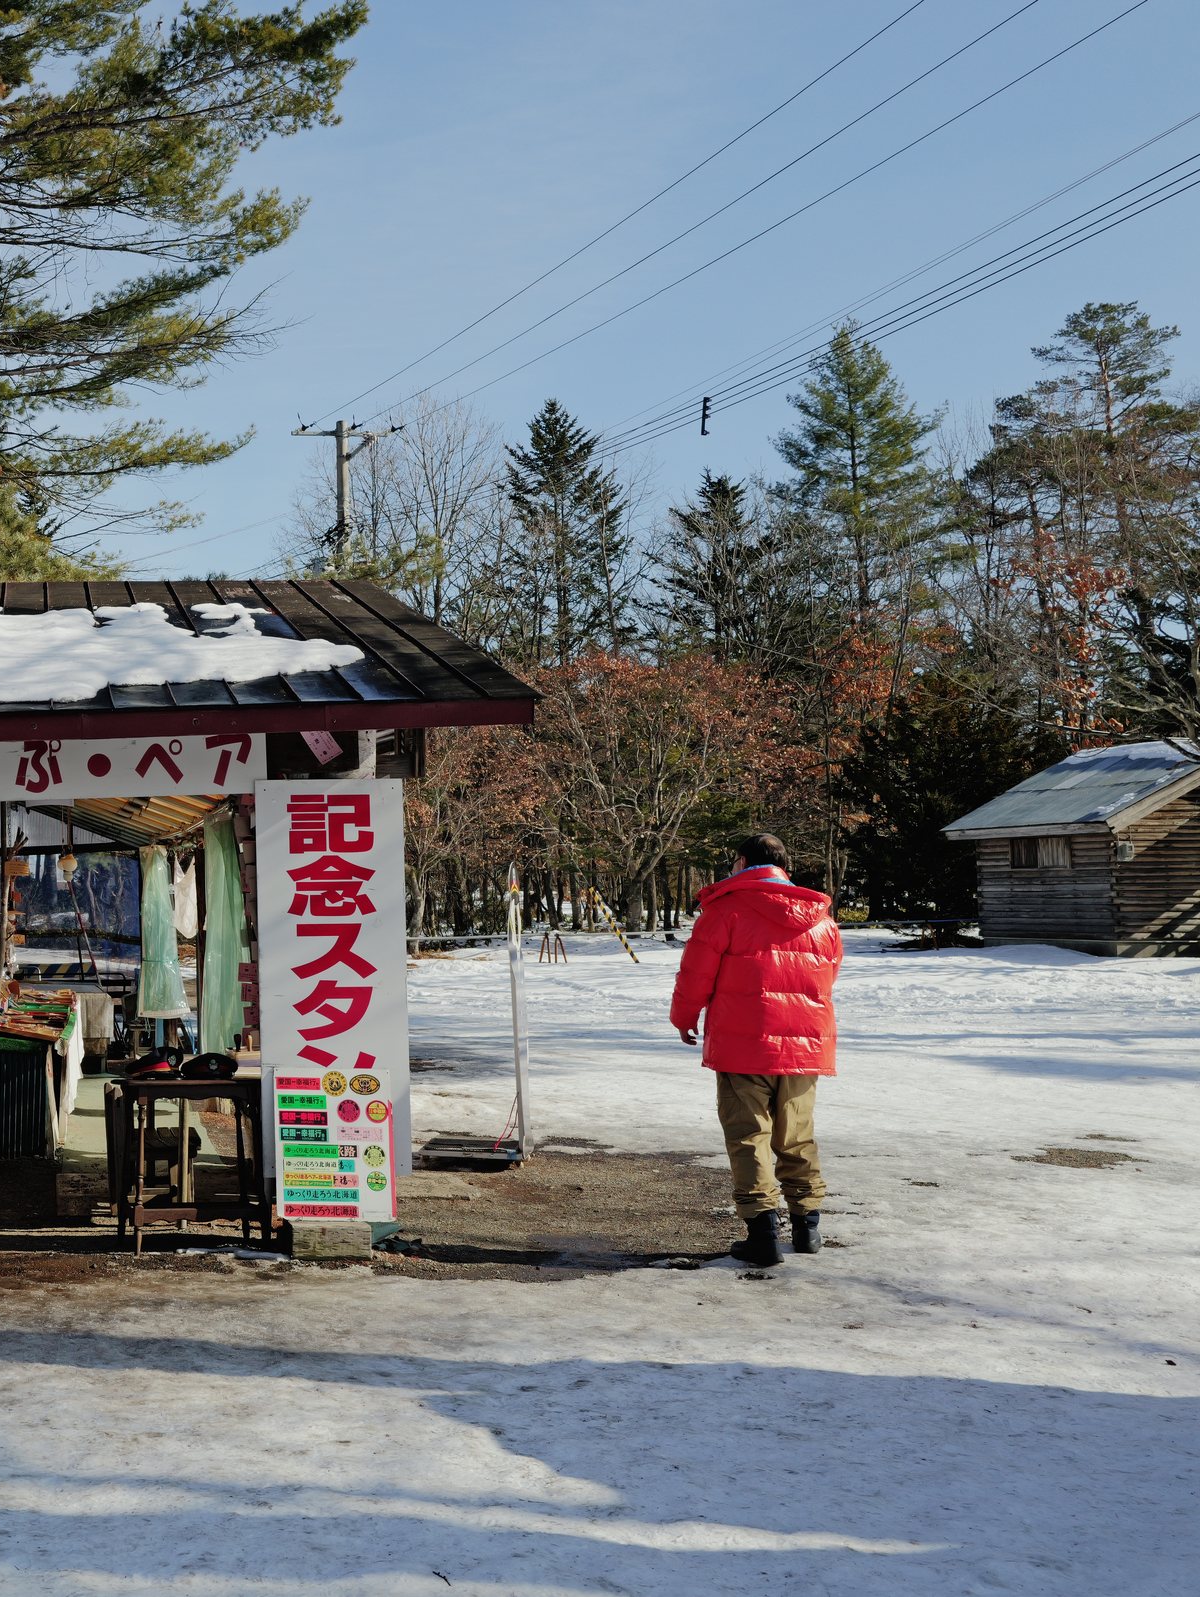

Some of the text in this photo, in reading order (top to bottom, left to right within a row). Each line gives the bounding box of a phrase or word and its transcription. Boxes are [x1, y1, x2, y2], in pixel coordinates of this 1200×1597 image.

[286, 1190, 358, 1200] ゆっくり走ろう北海道
[285, 1205, 358, 1217] ゆっくり走ろう北海道
